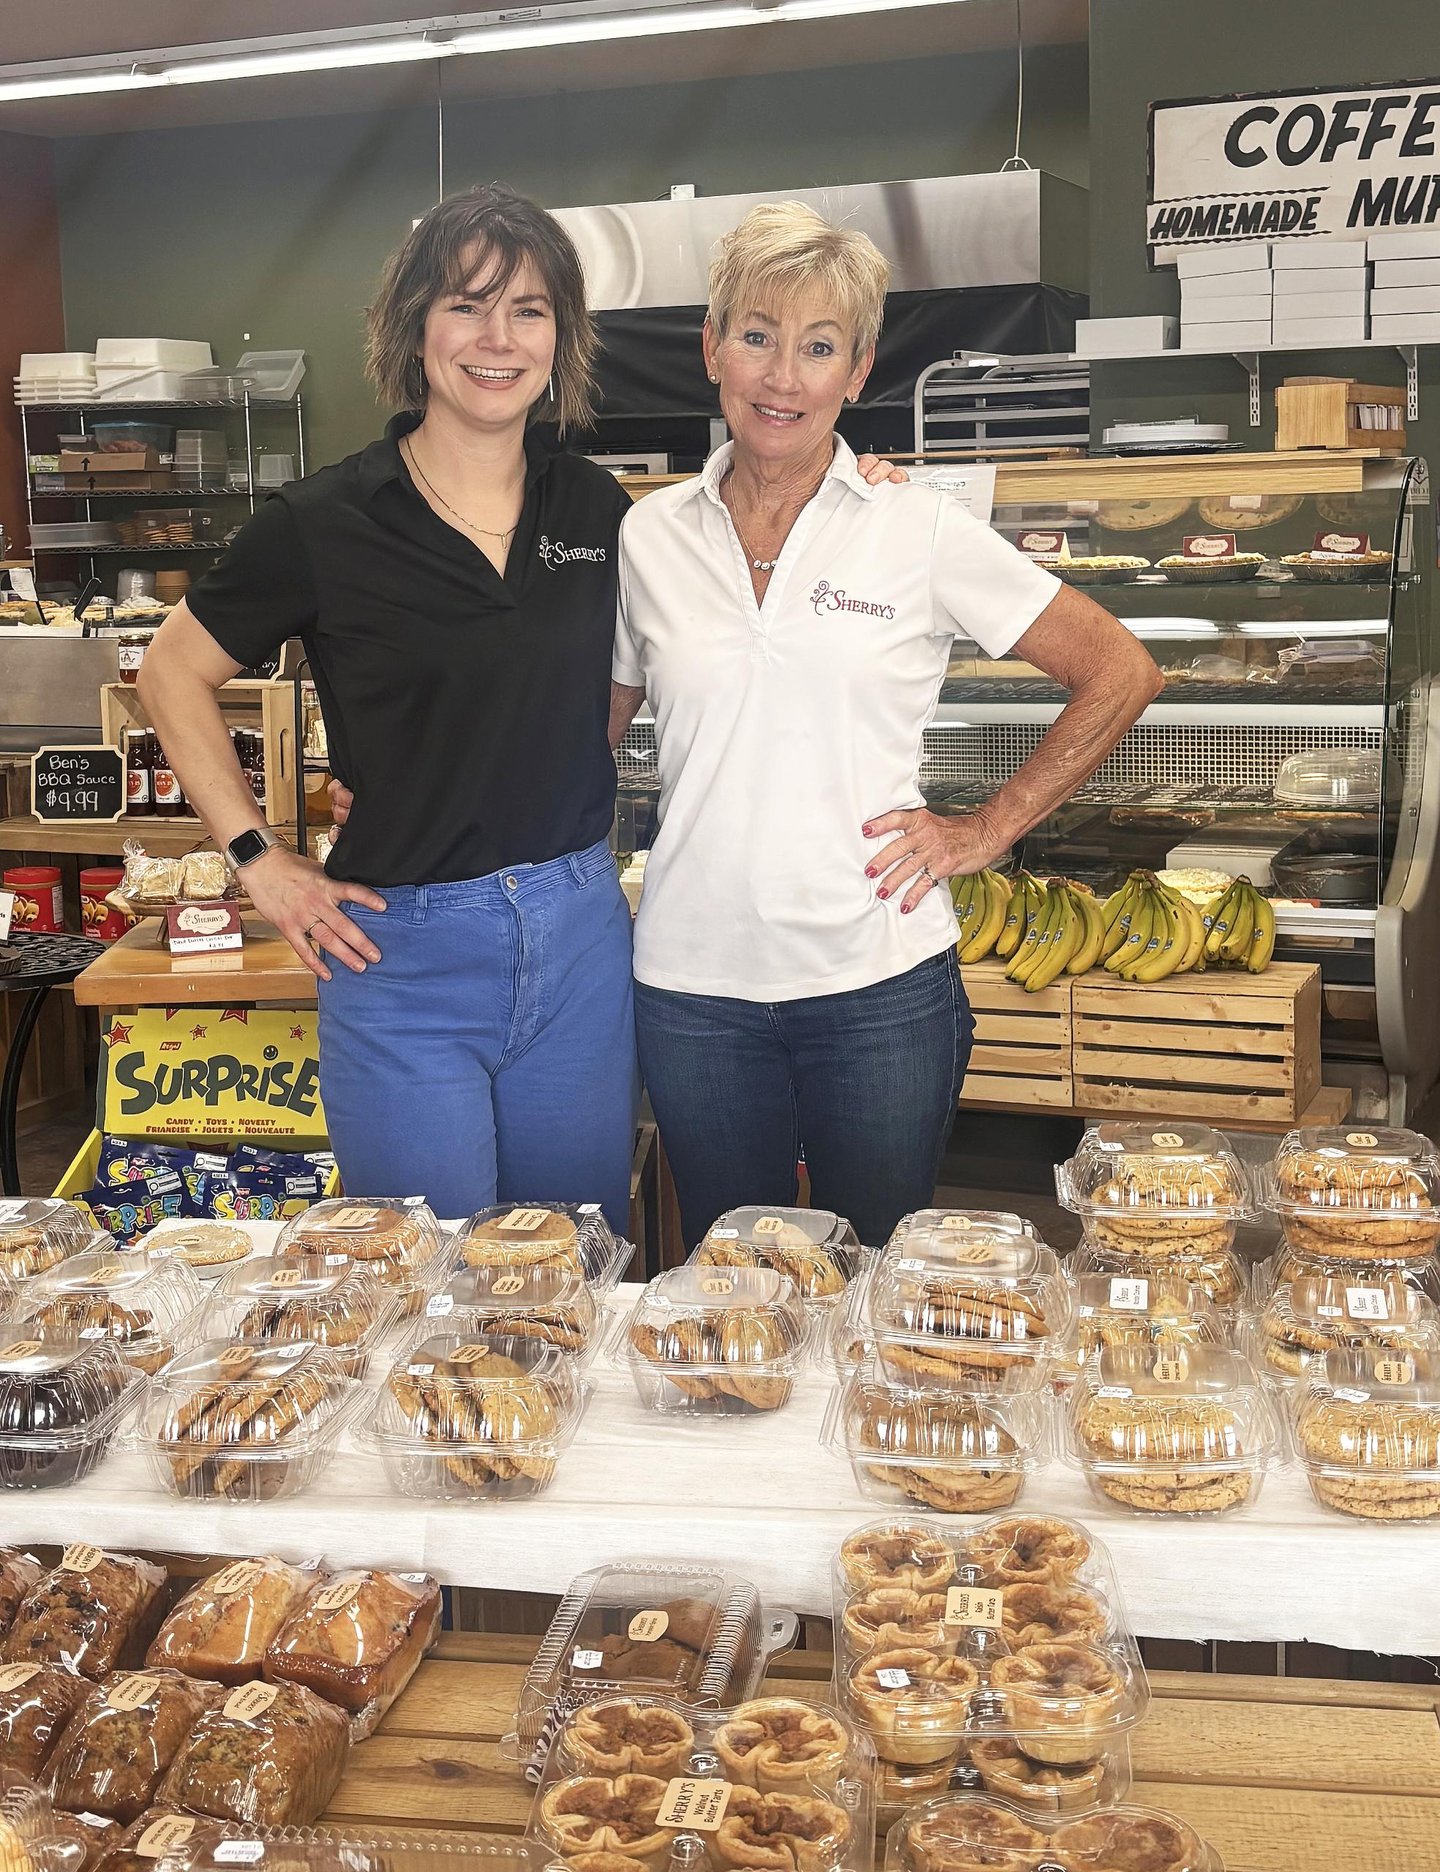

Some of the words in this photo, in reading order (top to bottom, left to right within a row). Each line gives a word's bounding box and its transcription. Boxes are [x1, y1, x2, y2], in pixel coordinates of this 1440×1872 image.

[1224, 94, 1440, 168] COFFE
[1150, 197, 1321, 239] HOMEMADE
[553, 541, 606, 564] SHERRY'S
[826, 589, 896, 620] SHERRY'S
[49, 754, 90, 770] Ben's
[38, 773, 71, 787] BBQ
[77, 774, 116, 785] Sauce
[46, 789, 98, 812] $9.99
[115, 1045, 321, 1117] SURPRISE
[145, 1126, 190, 1134] FRIANDISE
[202, 1126, 234, 1134] JOUETS
[239, 1118, 276, 1126] NOVELTY
[665, 1782, 696, 1823] SHERRY'S
[693, 1794, 710, 1815] Walnut
[710, 1789, 724, 1804] Tarts
[704, 1804, 718, 1823] Butter
